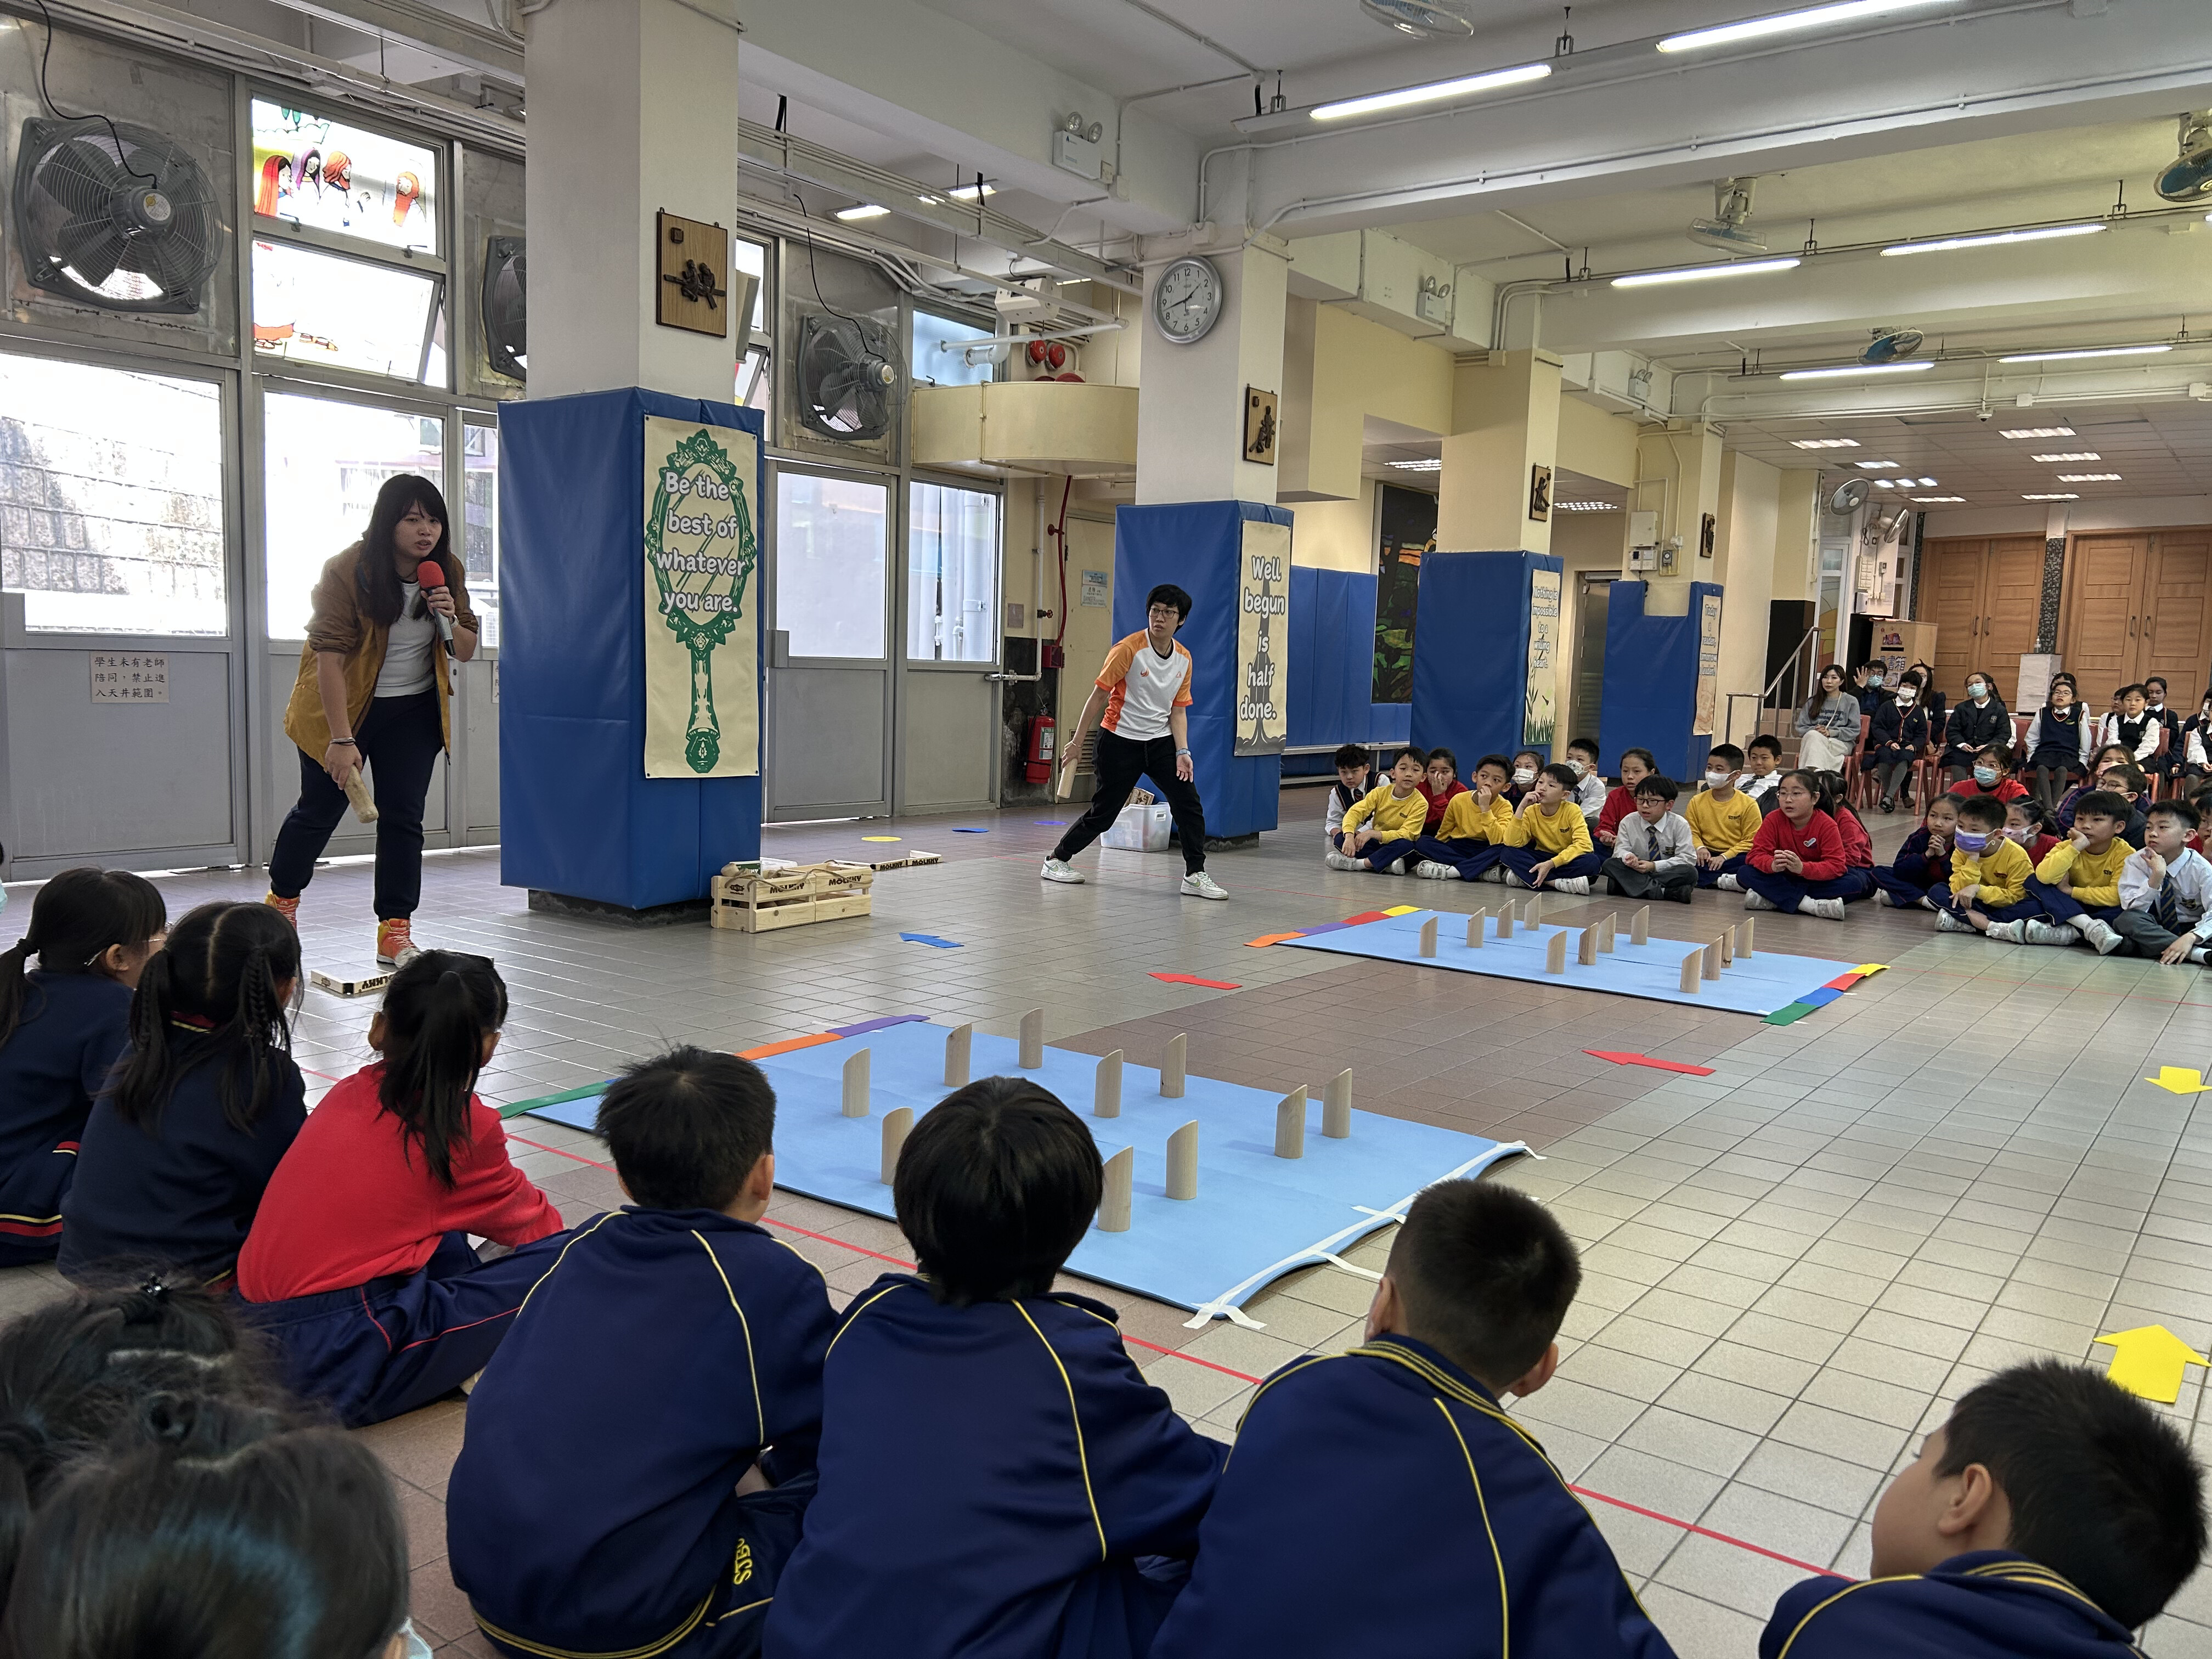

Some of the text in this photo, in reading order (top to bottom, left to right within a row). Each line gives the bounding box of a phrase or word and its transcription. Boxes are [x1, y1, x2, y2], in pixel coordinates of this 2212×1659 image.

[1174, 273, 1180, 282] 11
[1184, 268, 1190, 276] 12
[1197, 269, 1200, 278] 1
[1165, 285, 1172, 294] 10
[1204, 279, 1209, 287] 2
[1162, 298, 1167, 307] 9
[1207, 292, 1212, 301] 3
[1165, 312, 1170, 320] 8
[1173, 320, 1178, 329] 7
[1184, 323, 1189, 331] 6
[665, 471, 729, 500] Be the
[668, 509, 737, 539] best of
[656, 548, 746, 575] whatever
[1251, 556, 1282, 581] Well
[1533, 586, 1558, 602] Nothing is
[664, 591, 738, 614] you are.
[1244, 587, 1285, 619] begun
[1532, 603, 1558, 619] impossible
[1538, 621, 1548, 634] to a
[1258, 630, 1269, 653] is
[1534, 638, 1550, 654] willing
[94, 657, 165, 668] 學生未有老師
[95, 672, 165, 683] 陪同，禁止進
[1248, 663, 1275, 687] half
[95, 687, 162, 698] 入天井範圍。
[1240, 696, 1277, 720] done.
[880, 857, 939, 871] MÖLKKY MÖLKKY
